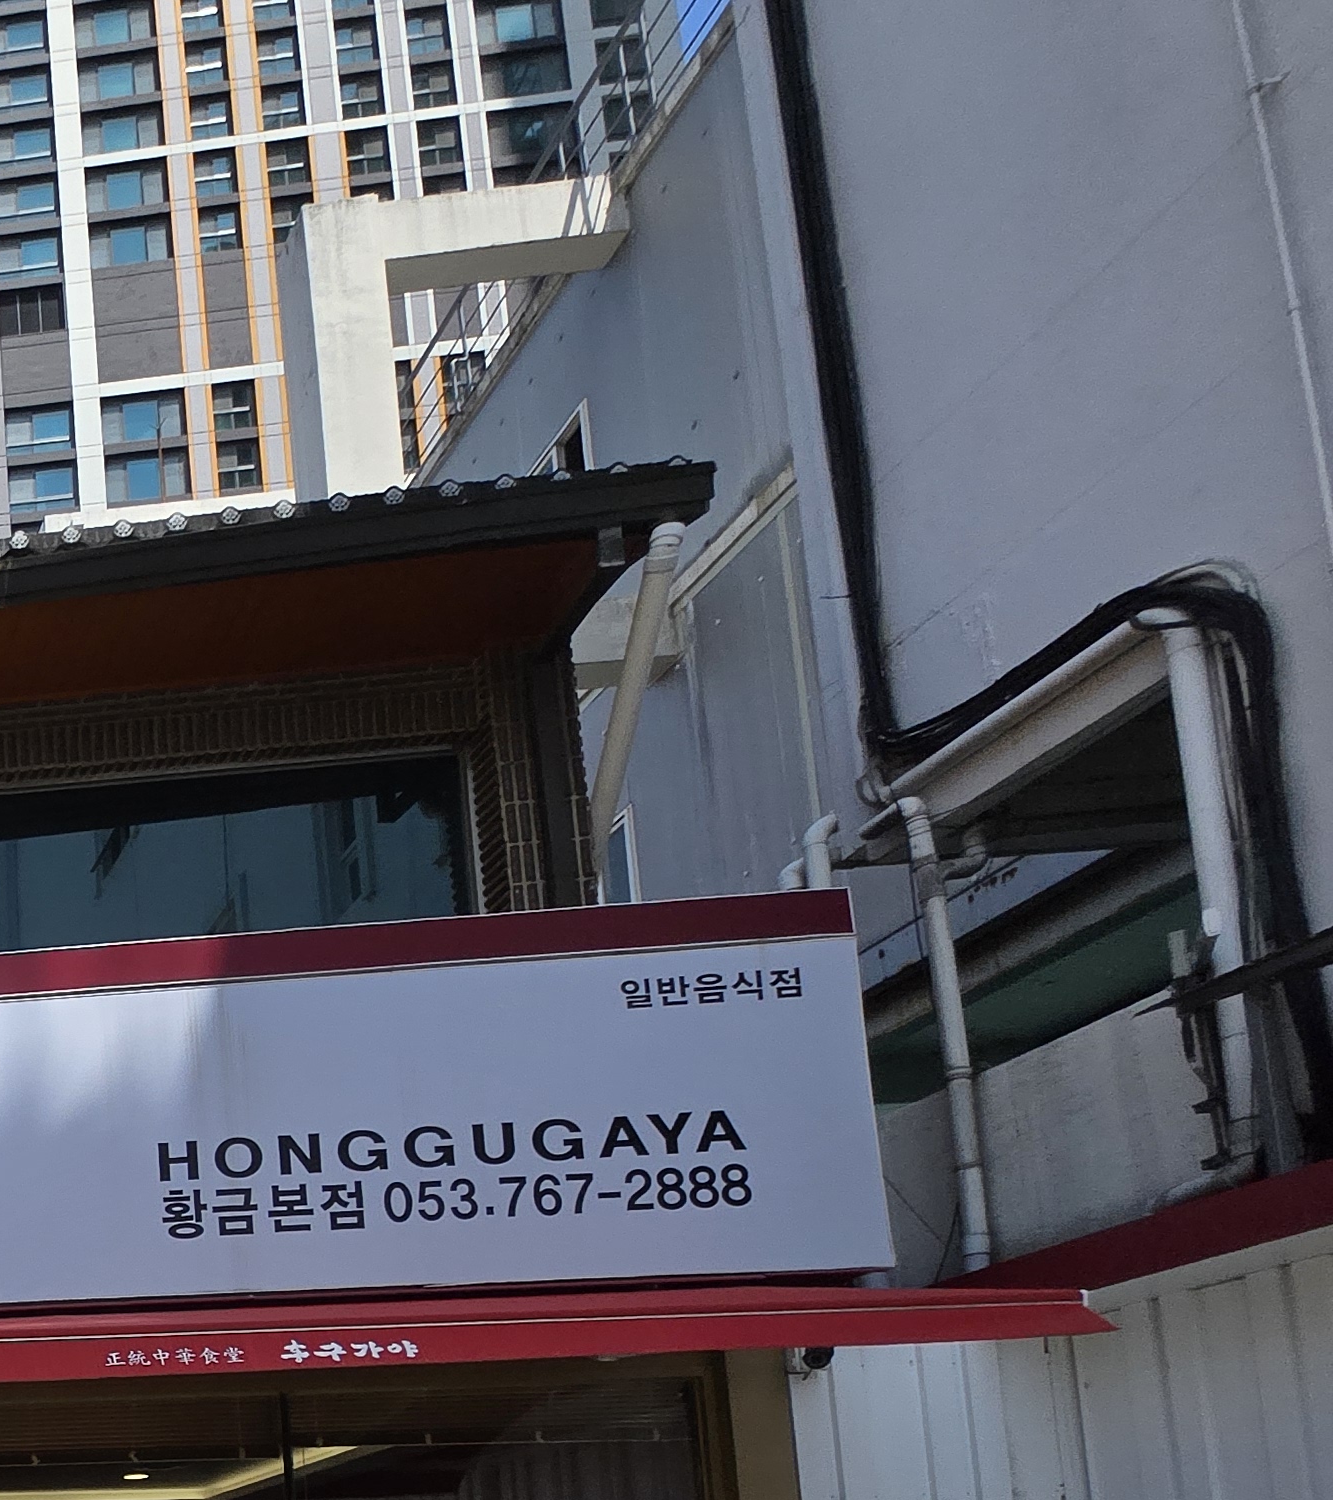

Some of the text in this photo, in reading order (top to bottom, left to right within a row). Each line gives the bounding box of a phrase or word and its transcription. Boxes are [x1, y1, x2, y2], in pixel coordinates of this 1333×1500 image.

[619, 967, 804, 1009] 일반음식점
[157, 1109, 747, 1182] HONGGUGAYA
[161, 1164, 753, 1239] 황금본점 053.767-2888
[104, 1345, 245, 1368] 正統中華食堂
